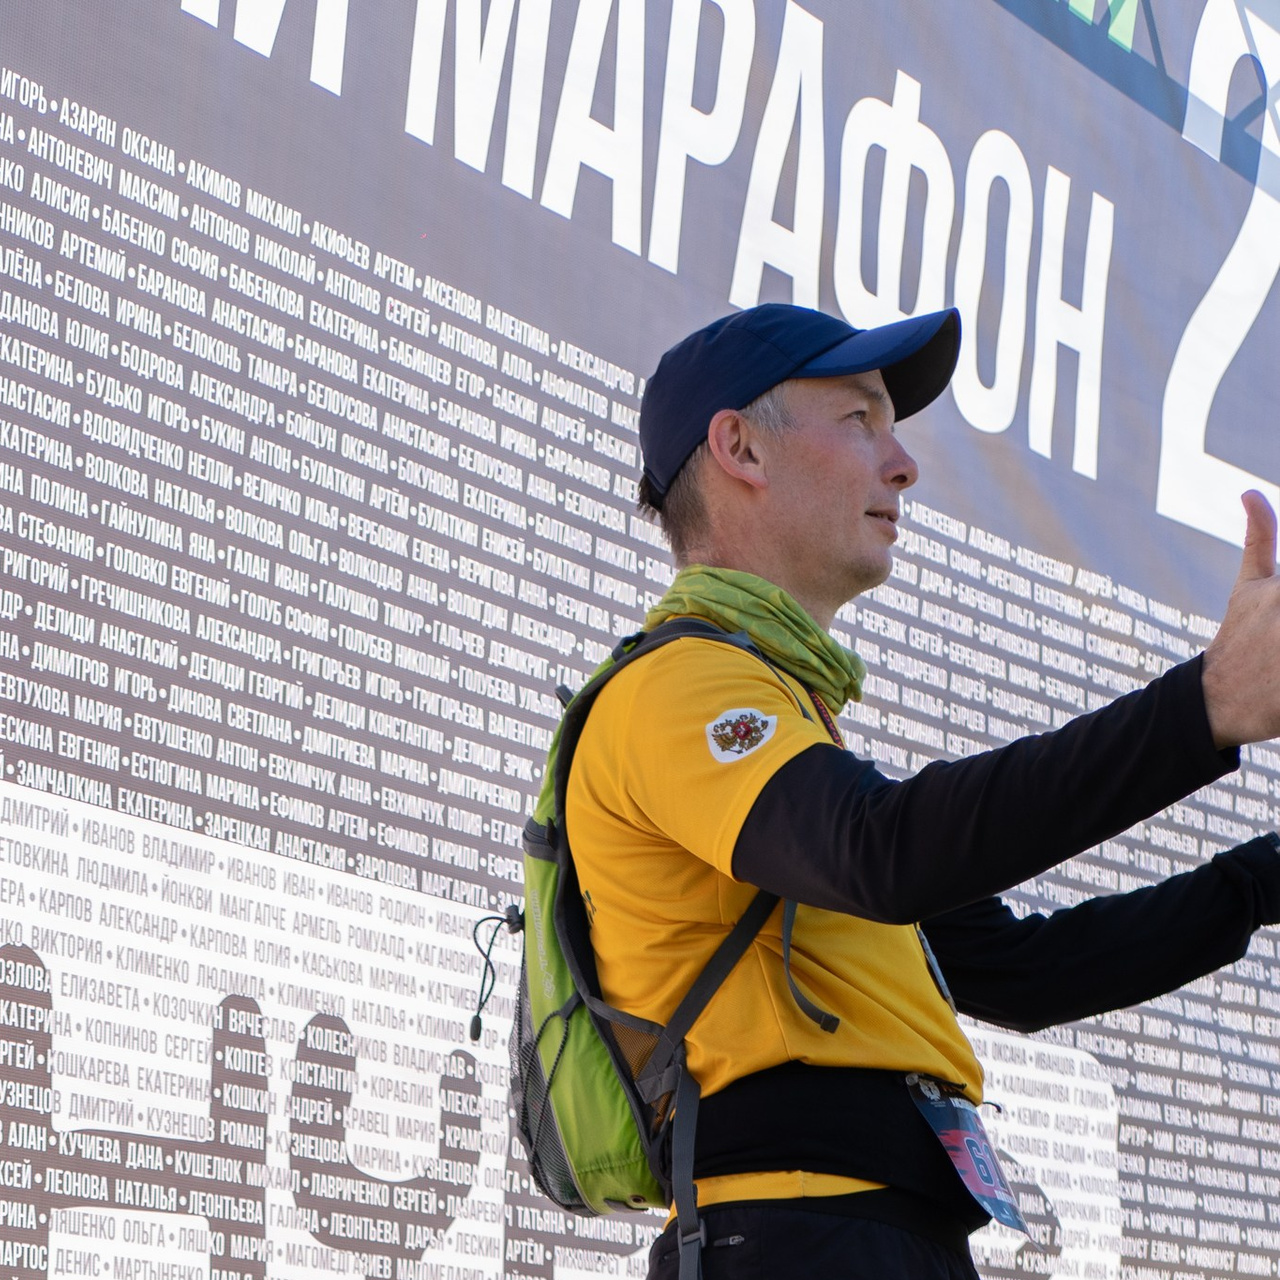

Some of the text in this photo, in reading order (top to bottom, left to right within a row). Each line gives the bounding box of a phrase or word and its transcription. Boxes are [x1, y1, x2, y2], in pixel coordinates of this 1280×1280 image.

[325, 269, 532, 386] АНТОНОВ СЕРГЕЙ АНТОНОВА АЛЛА
[388, 338, 485, 400] БАБИНЦЕВ ЕГОР
[422, 276, 634, 395] АКСЕНОВА ВАЛЕНТИНА АЛЕКСАНДРОВ
[105, 542, 329, 641] ГОЛОВКО ЕВГЕНИЙ ГОЛУБ СОФИЯ
[226, 546, 424, 636] ГАЛАН ИВАН ГАЛУШКО ТИМУР
[1, 797, 216, 875] ДМИТРИЙ ИВАНОВ ВЛАДИМИР
[76, 856, 149, 897] ЛЮДМИЛА
[61, 972, 140, 1009] ЕЛИЗАВЕТА
